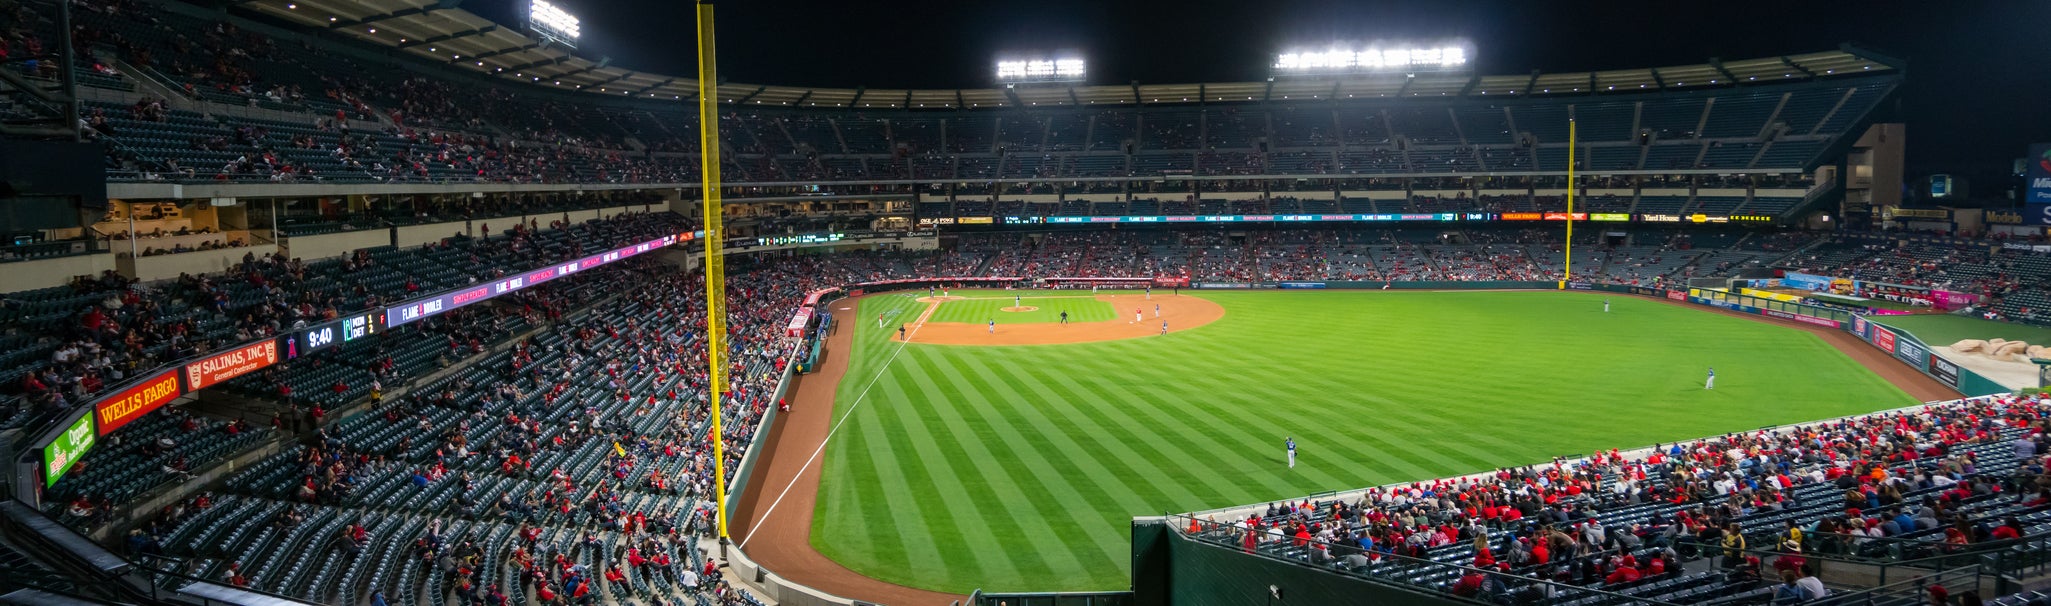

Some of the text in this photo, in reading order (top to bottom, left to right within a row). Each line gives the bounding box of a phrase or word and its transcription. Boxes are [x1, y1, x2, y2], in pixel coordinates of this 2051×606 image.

[1986, 210, 2023, 223] Modelo
[367, 314, 373, 324] 1
[380, 314, 384, 324] F
[402, 304, 419, 321] FLAME
[309, 327, 332, 347] 9:40
[352, 324, 374, 338] DET 2
[202, 345, 265, 374] SALINAS, INC.
[214, 362, 258, 381] General Contractor
[100, 376, 177, 425] WELLS FARGO
[68, 418, 89, 446] Organic
